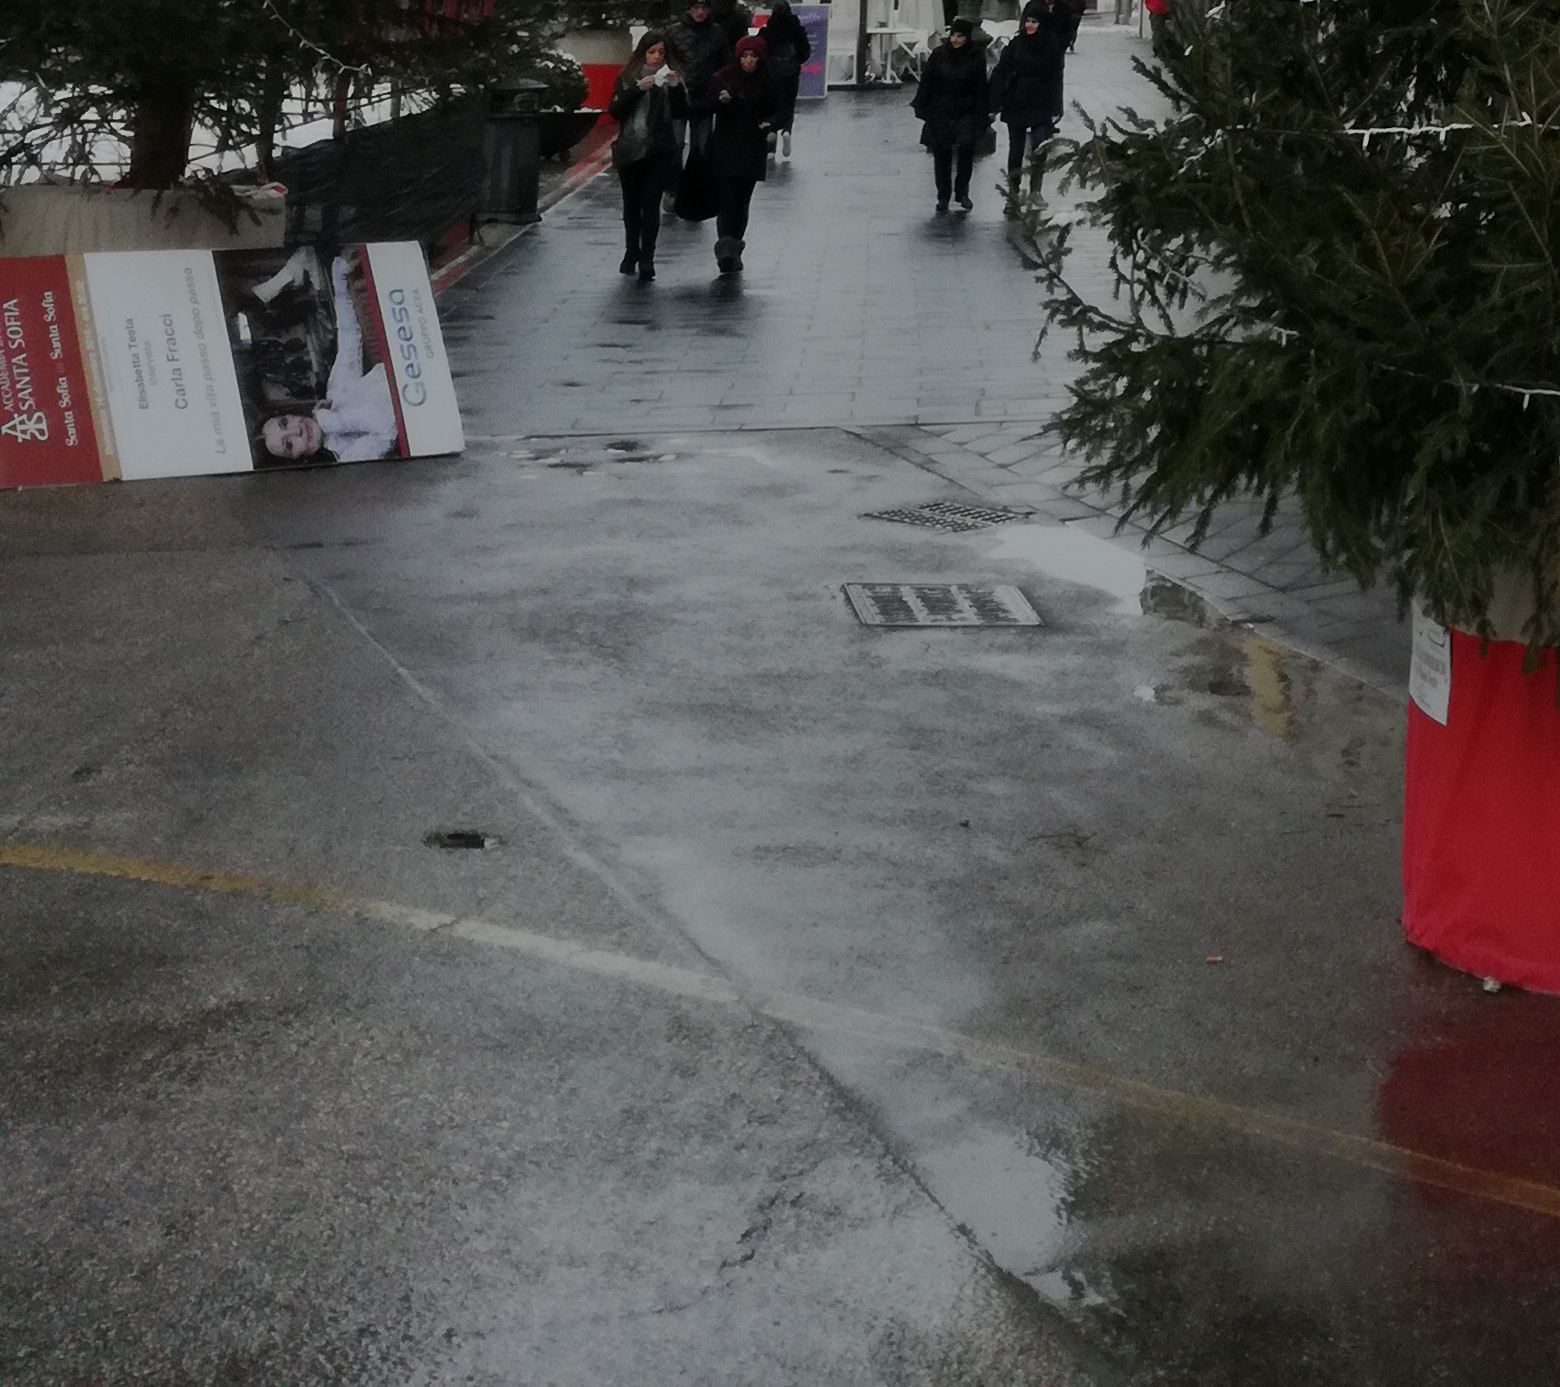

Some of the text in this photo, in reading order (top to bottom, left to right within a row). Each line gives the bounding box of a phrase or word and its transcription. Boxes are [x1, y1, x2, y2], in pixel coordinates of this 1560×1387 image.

[41, 291, 57, 322] Sofia
[388, 288, 427, 407] Gesesa
[412, 288, 434, 359] GRUPPO ACEA
[2, 298, 36, 410] SANTA SOFIA
[56, 377, 72, 408] Sofia
[126, 318, 149, 410] Elisabetta Testa
[159, 313, 188, 410] Carla Fracci
[184, 267, 226, 455] La mia vita passo dopo passo
[64, 411, 78, 446] Santa
